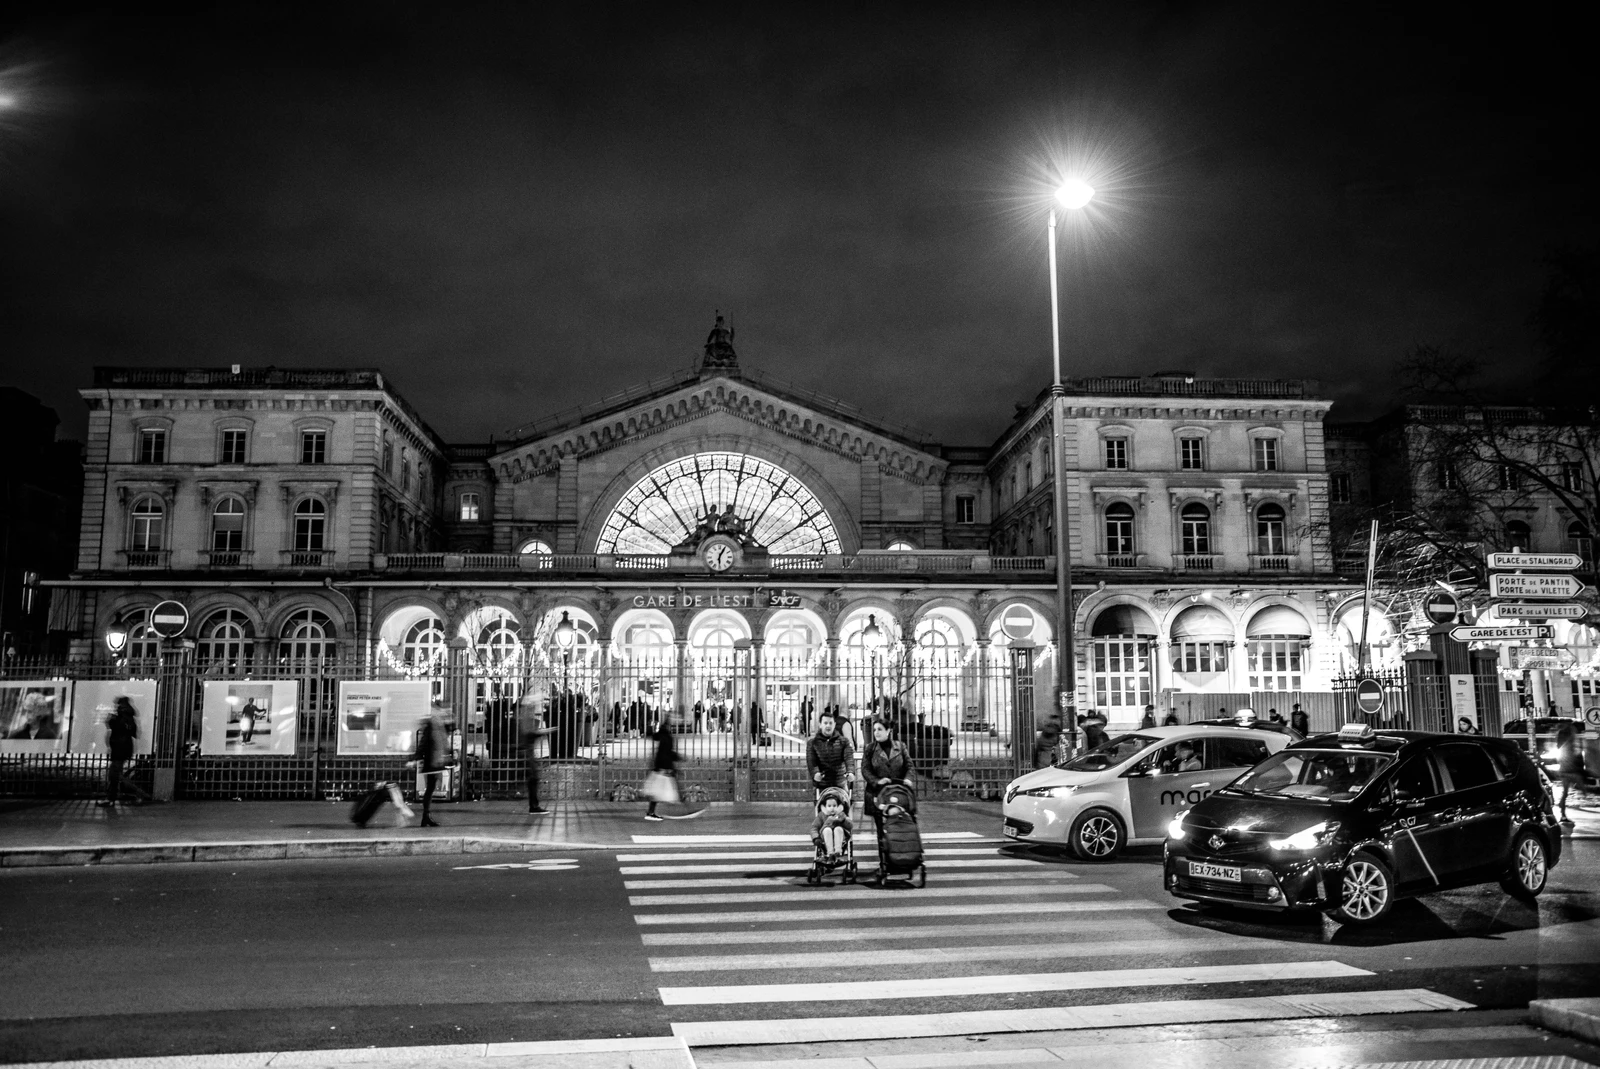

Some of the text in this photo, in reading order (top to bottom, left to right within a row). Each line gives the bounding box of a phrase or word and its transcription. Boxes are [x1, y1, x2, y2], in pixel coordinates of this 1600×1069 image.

[1529, 557, 1573, 565] STALINGRAD
[1541, 587, 1570, 595] VILETTE
[633, 595, 750, 607] GARE DE L'EST
[770, 596, 799, 605] SNCF
[1501, 607, 1524, 615] PARC
[1470, 629, 1494, 637] GARE
[1496, 629, 1509, 637] DE
[1510, 628, 1533, 636] L'EST
[1194, 864, 1235, 878] EX-734-NZ
